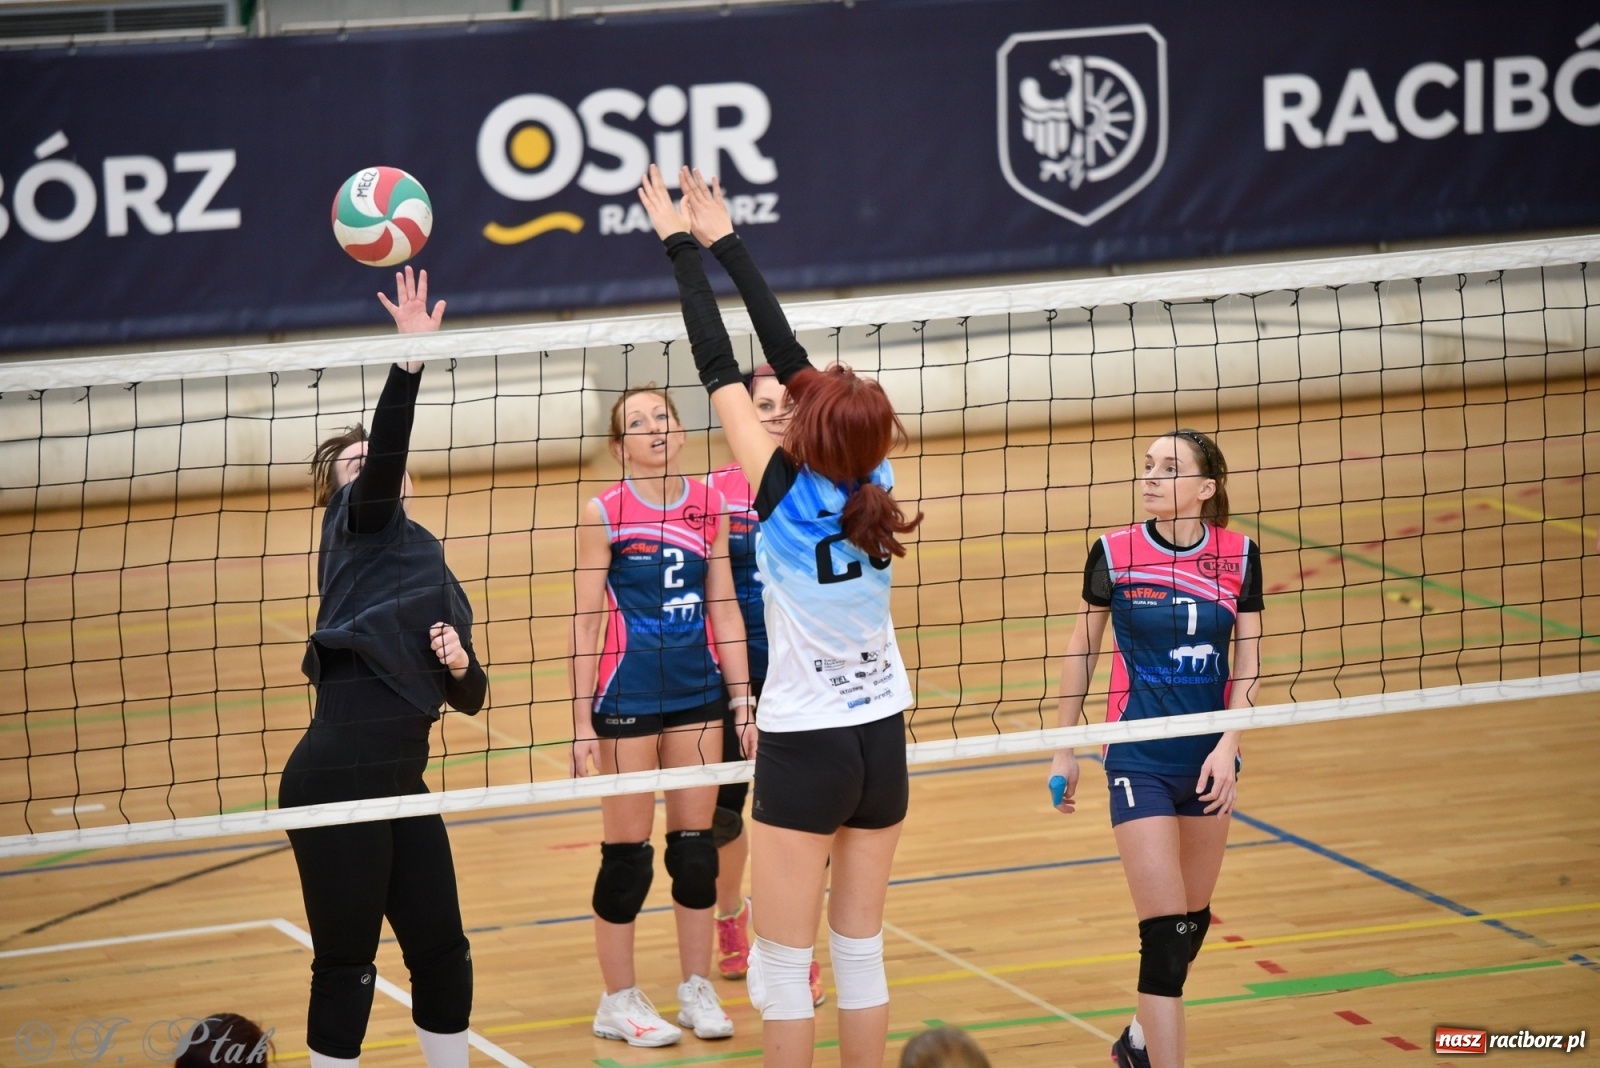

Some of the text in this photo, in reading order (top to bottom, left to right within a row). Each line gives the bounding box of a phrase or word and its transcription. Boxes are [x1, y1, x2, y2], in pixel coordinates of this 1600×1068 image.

[476, 81, 778, 202] OSiR
[356, 171, 378, 198] MECZ
[663, 548, 684, 588] 2
[1173, 597, 1197, 635] 7
[1114, 777, 1135, 807] 7
